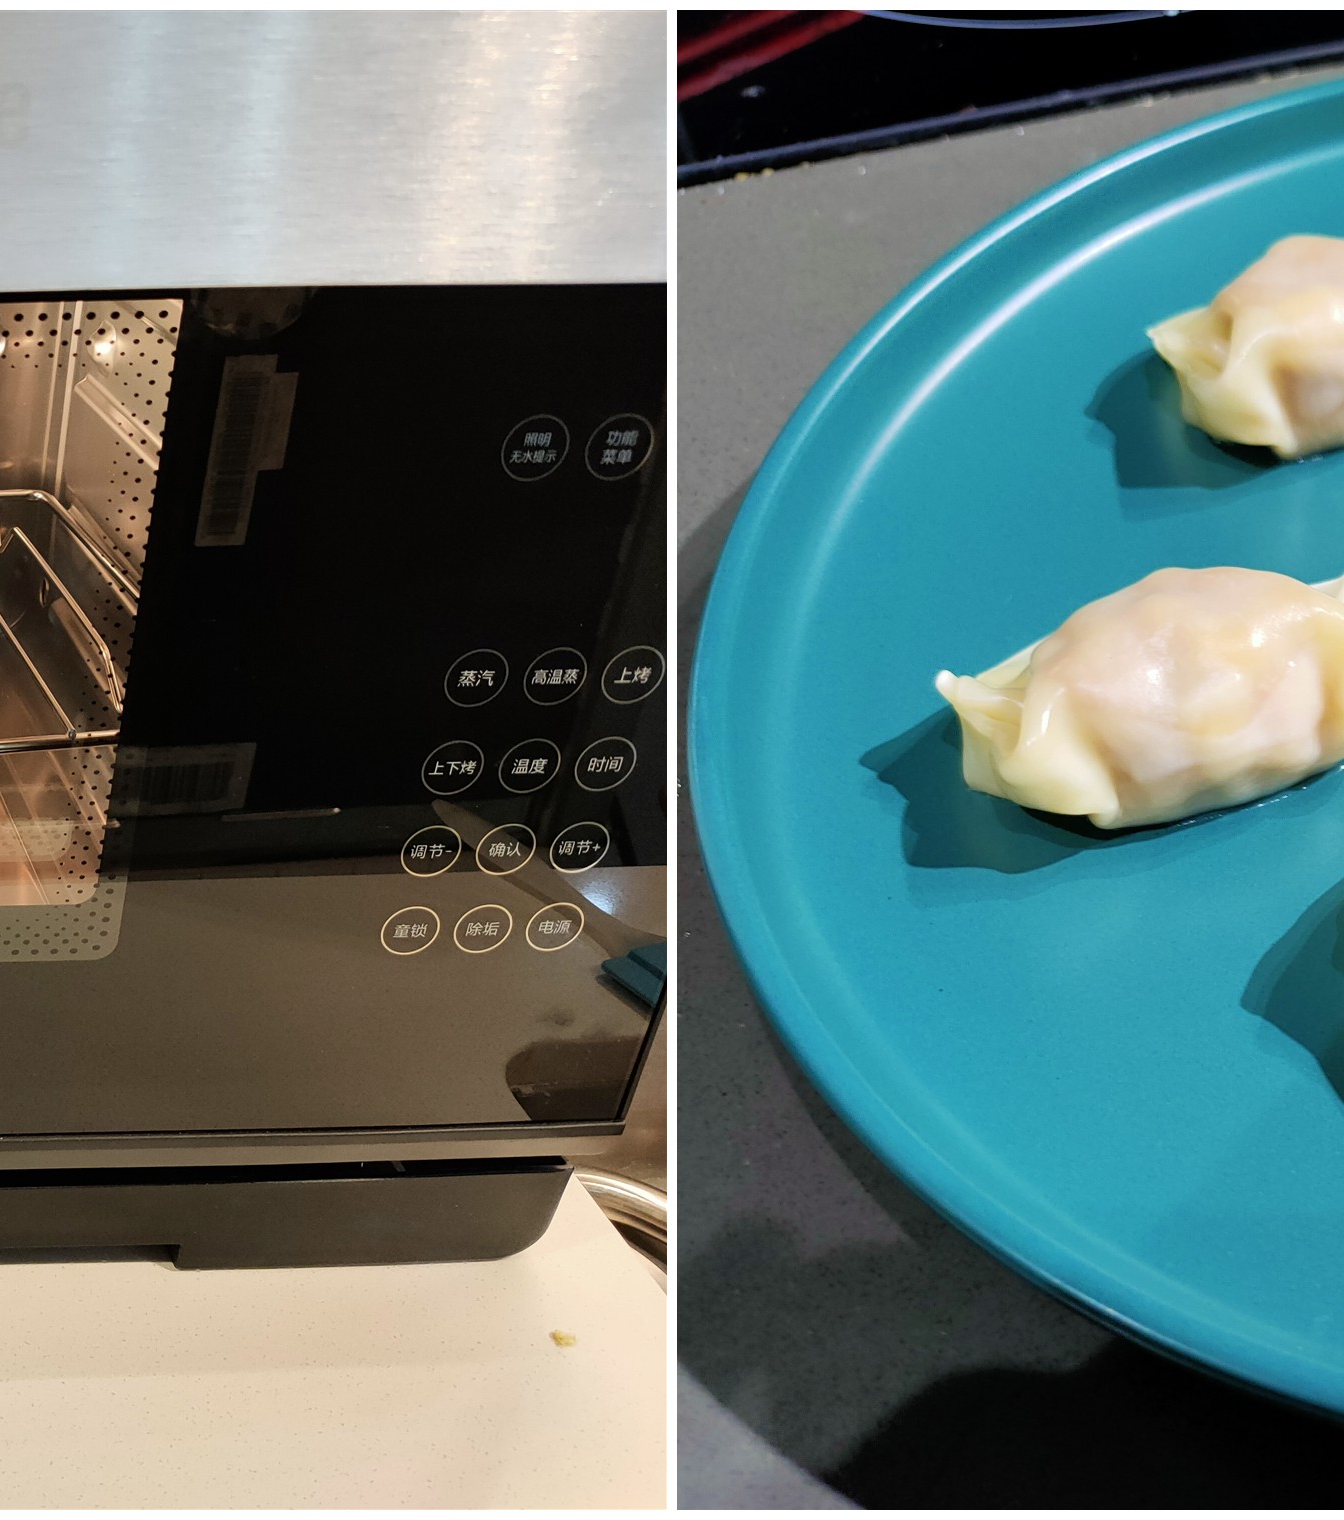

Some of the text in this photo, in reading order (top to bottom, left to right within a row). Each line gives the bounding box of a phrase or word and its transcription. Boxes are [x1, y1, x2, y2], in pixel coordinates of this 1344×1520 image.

[523, 432, 552, 447] 照明
[605, 430, 639, 447] 功能
[509, 449, 557, 464] 无水提示
[600, 449, 633, 465] 菜单
[457, 670, 495, 687] 蒸汽
[531, 669, 579, 685] 高温蒸
[614, 667, 652, 684] 上烤
[428, 760, 477, 776] 上下烤
[511, 758, 548, 775] 温度
[587, 756, 623, 773] 时间
[488, 842, 522, 857] 确认
[558, 840, 601, 856] 调节+
[392, 923, 427, 938] 童锁
[465, 922, 500, 937] 除垢
[538, 920, 571, 935] 电源
